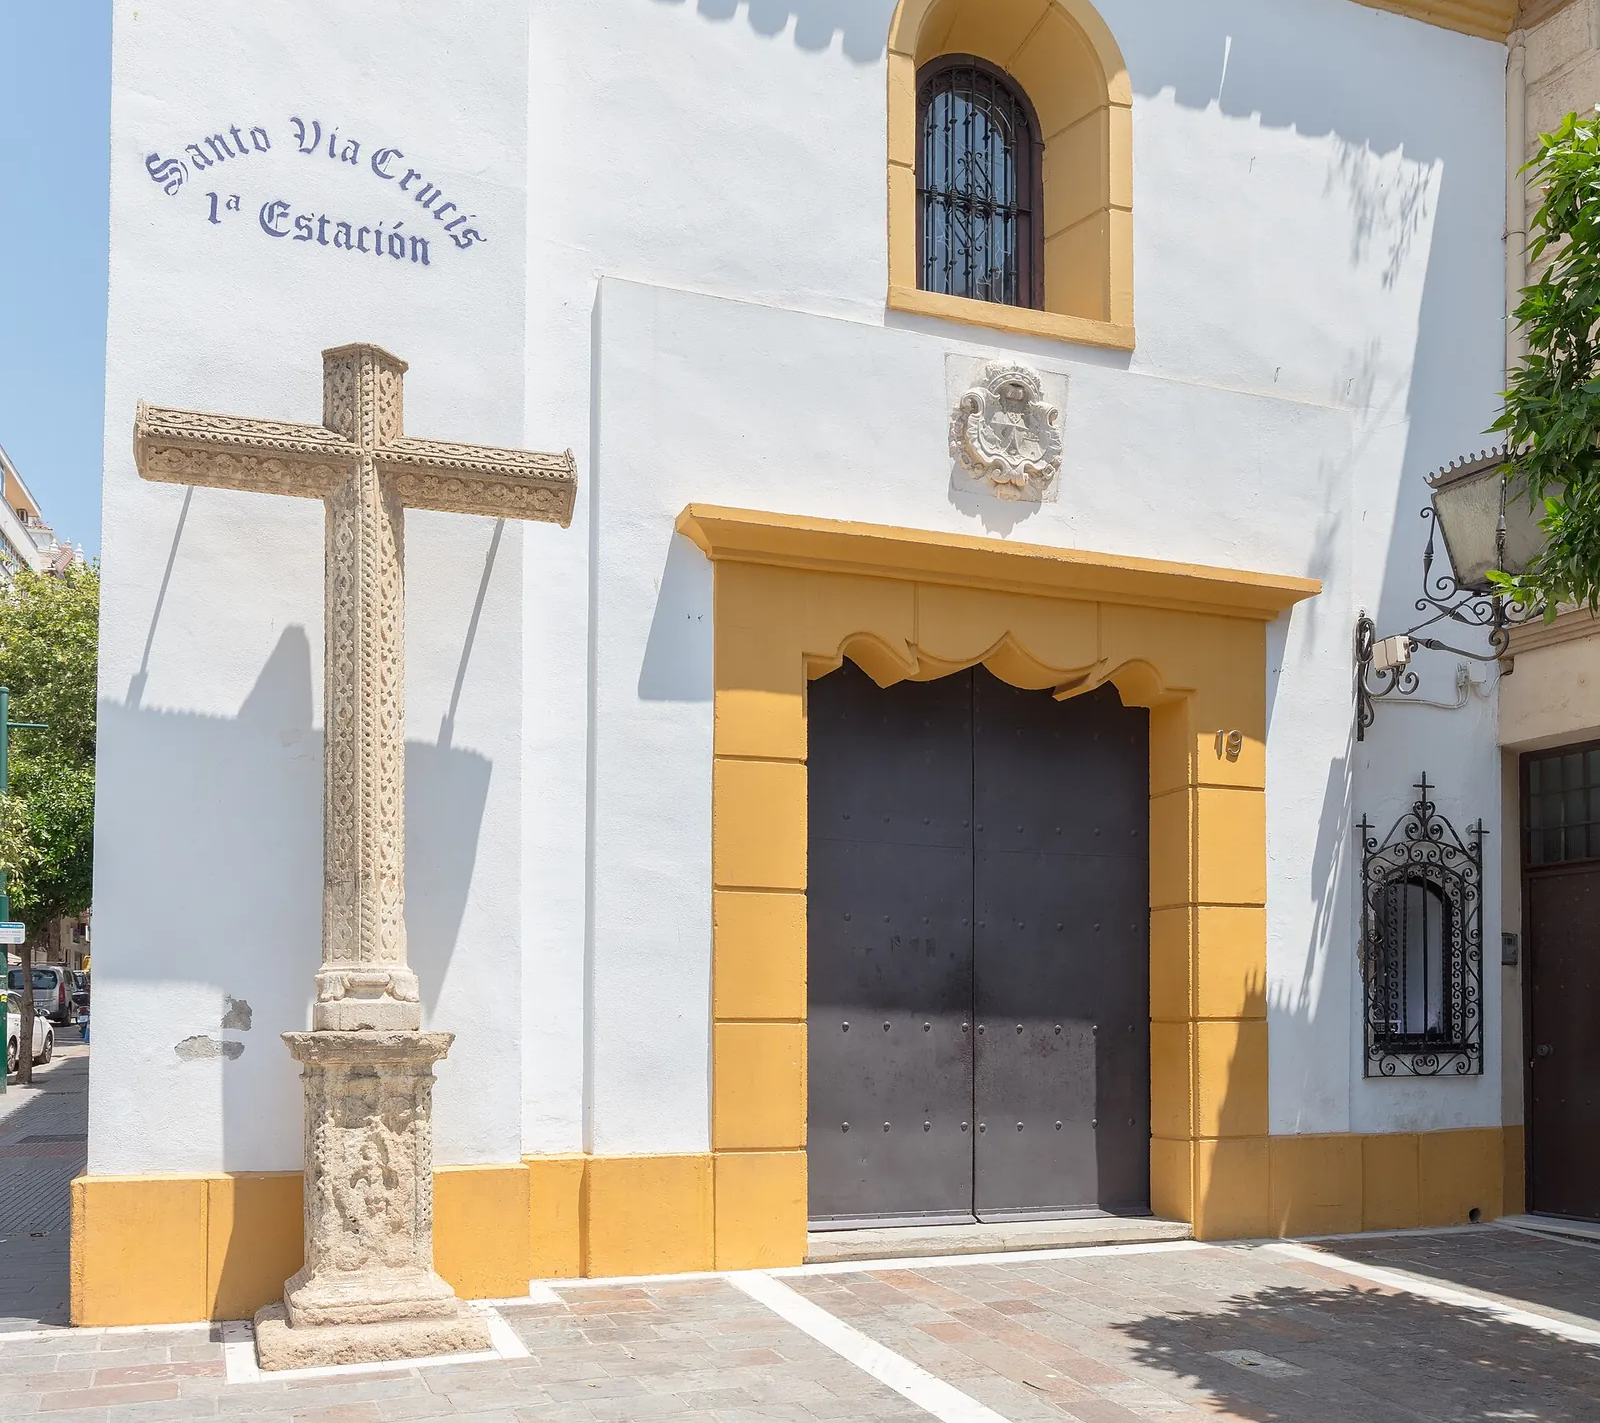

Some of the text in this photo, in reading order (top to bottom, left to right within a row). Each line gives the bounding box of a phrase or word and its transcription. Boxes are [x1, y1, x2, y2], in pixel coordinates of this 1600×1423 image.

[145, 124, 272, 196] Santo
[371, 147, 487, 250] Crucis
[258, 199, 431, 266] Estación
[1216, 729, 1243, 756] 19
